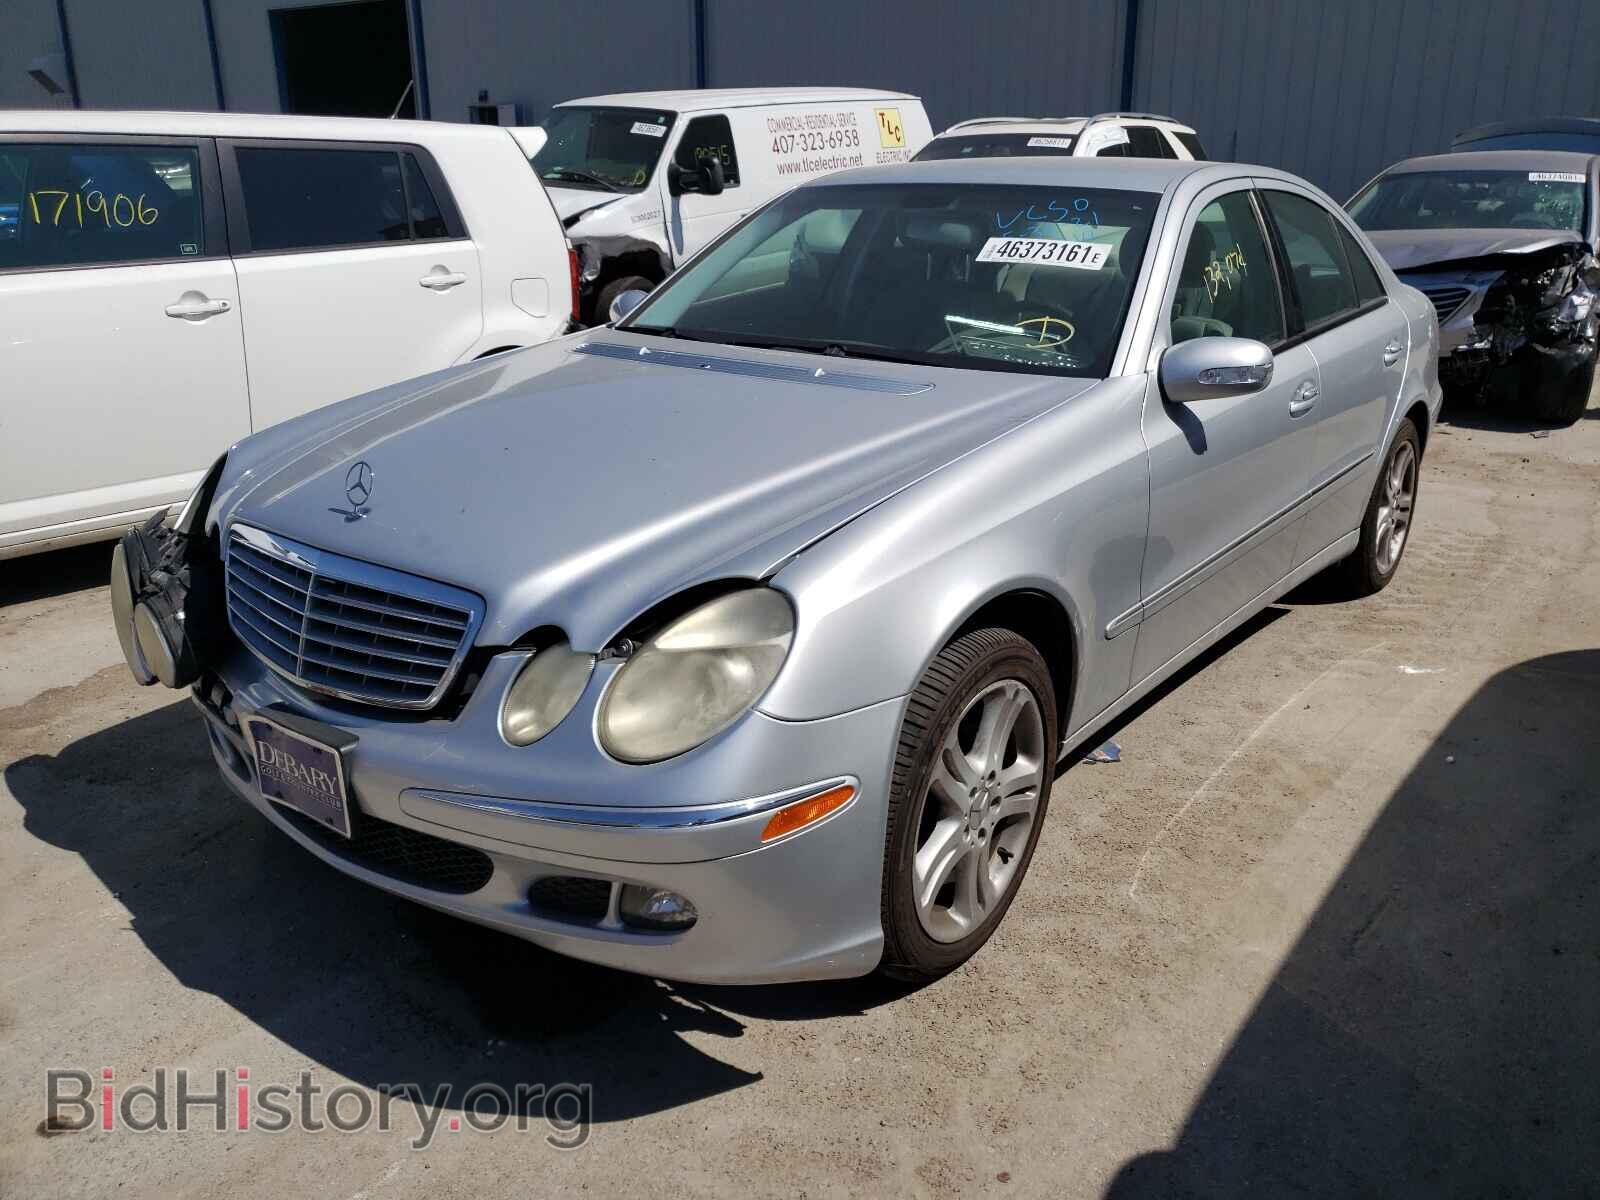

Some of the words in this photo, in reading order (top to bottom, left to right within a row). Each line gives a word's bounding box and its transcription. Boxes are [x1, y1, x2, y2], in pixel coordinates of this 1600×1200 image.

[772, 129, 860, 154] 407-323-6958
[777, 152, 864, 175] www.tlcelectric.net
[29, 190, 159, 229] 171906
[996, 241, 1092, 264] 46373161
